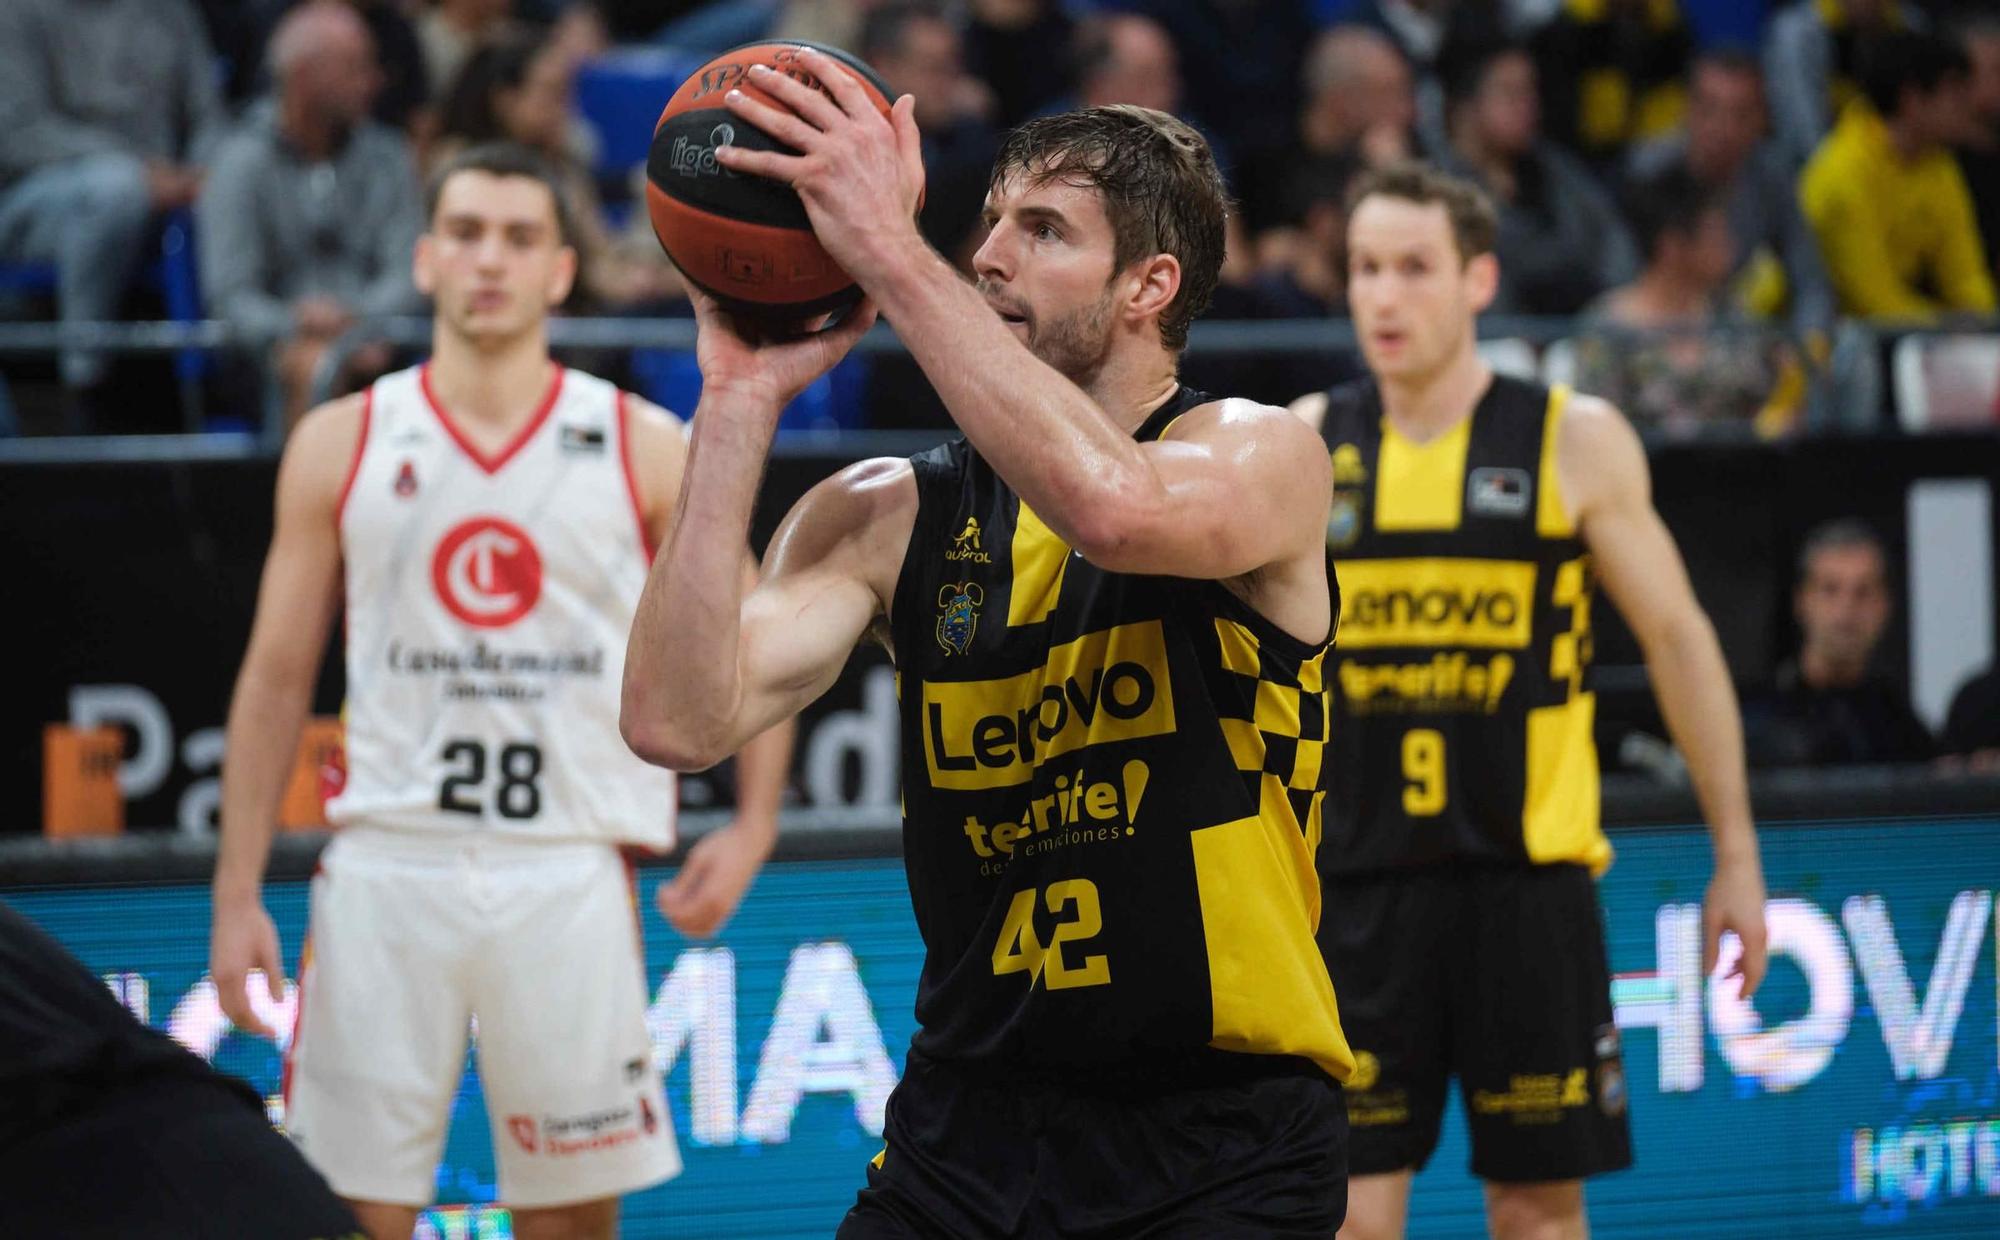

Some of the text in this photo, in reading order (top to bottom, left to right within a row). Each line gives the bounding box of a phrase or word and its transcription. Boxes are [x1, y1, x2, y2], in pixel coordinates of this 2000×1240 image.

[439, 740, 543, 820] 28
[1401, 729, 1447, 816] 9
[991, 878, 1111, 991] 42
